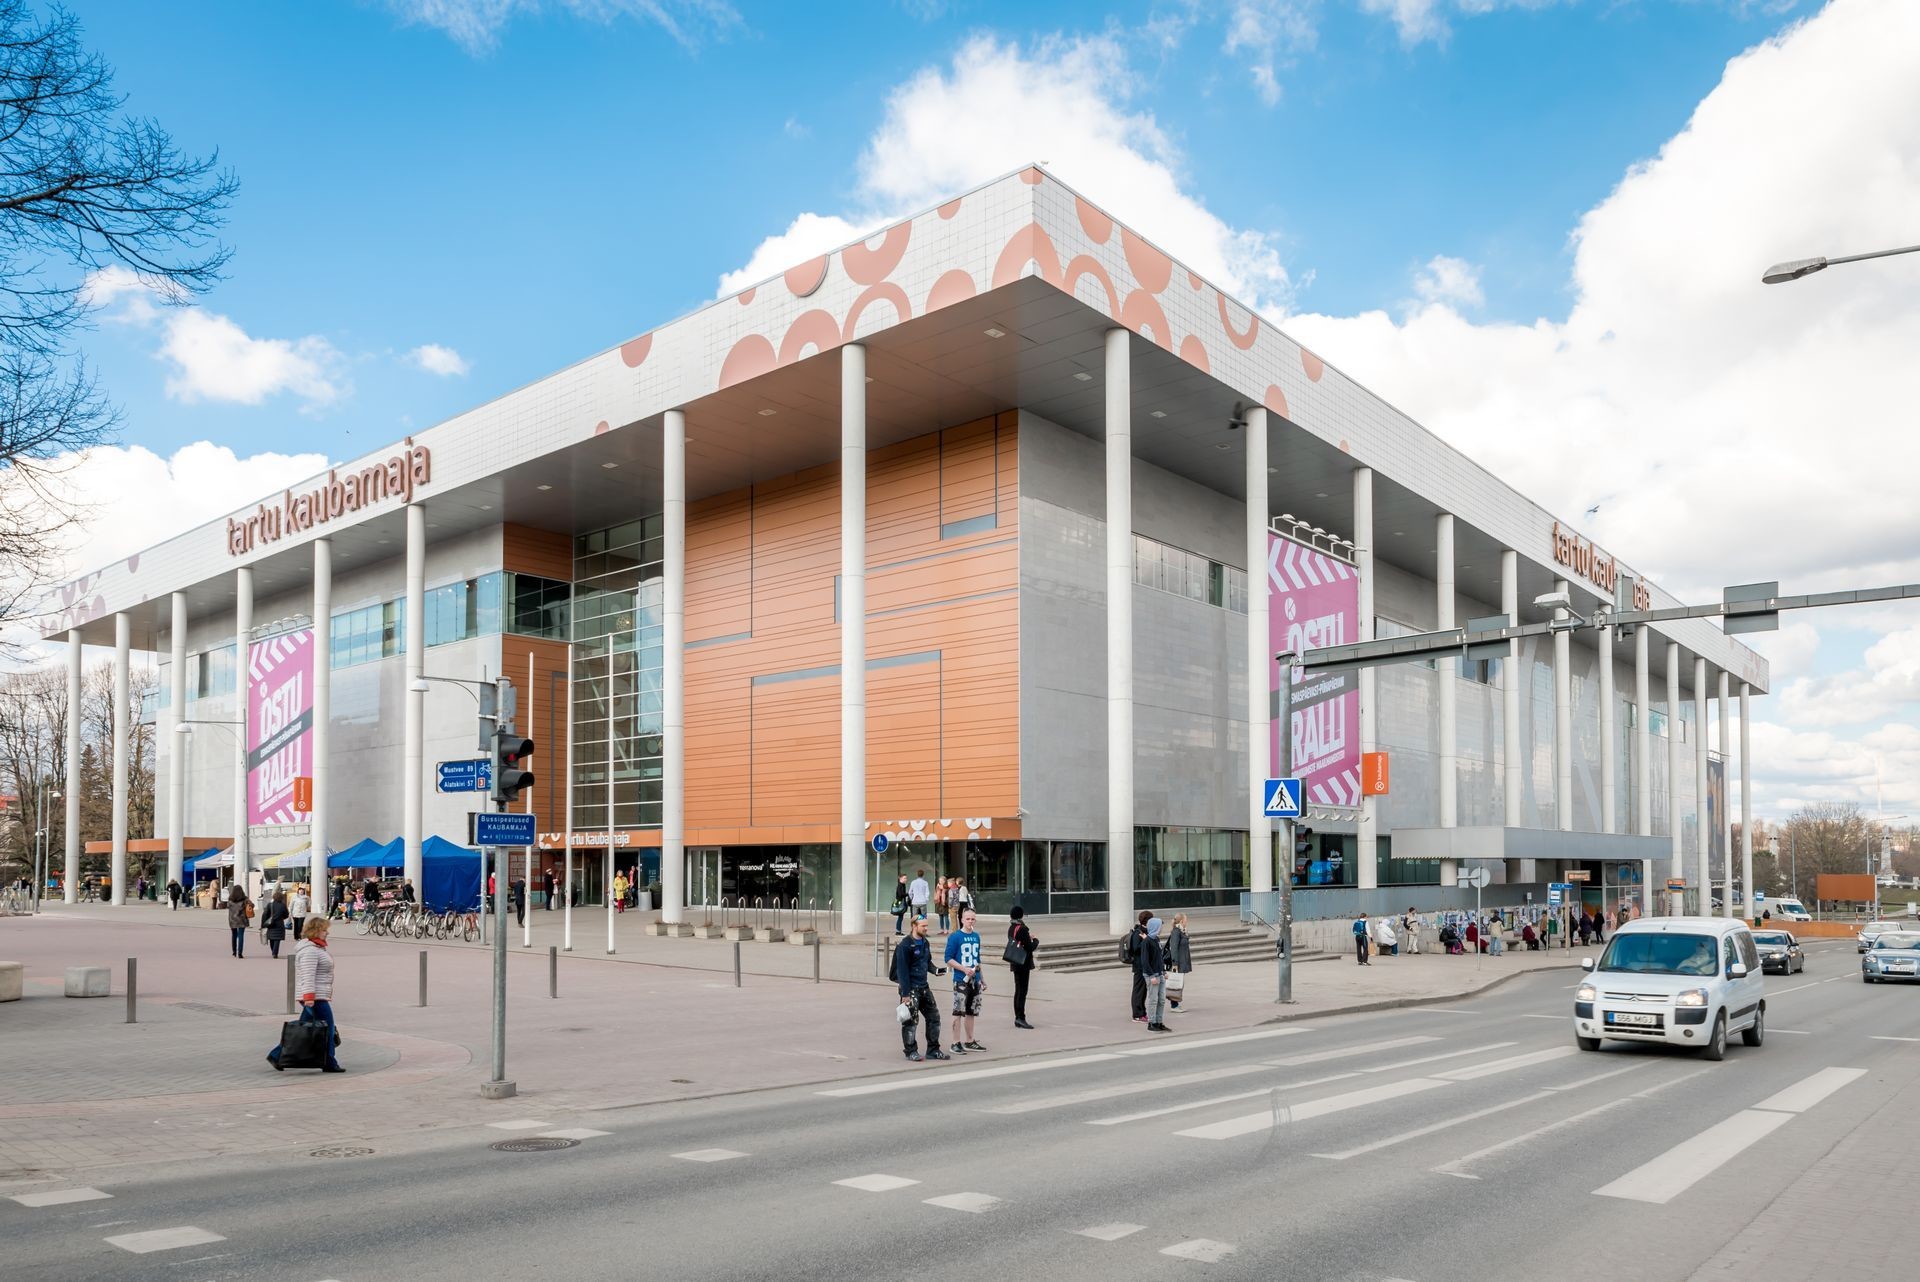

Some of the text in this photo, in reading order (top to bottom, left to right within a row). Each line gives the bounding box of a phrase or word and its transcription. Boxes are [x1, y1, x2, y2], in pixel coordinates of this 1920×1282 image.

[227, 436, 431, 557] tartu kaubamaja
[1552, 521, 1589, 577] tartu
[1291, 694, 1345, 770] RALLI
[258, 734, 302, 804] RALLI
[481, 815, 530, 824] Bussipeatused
